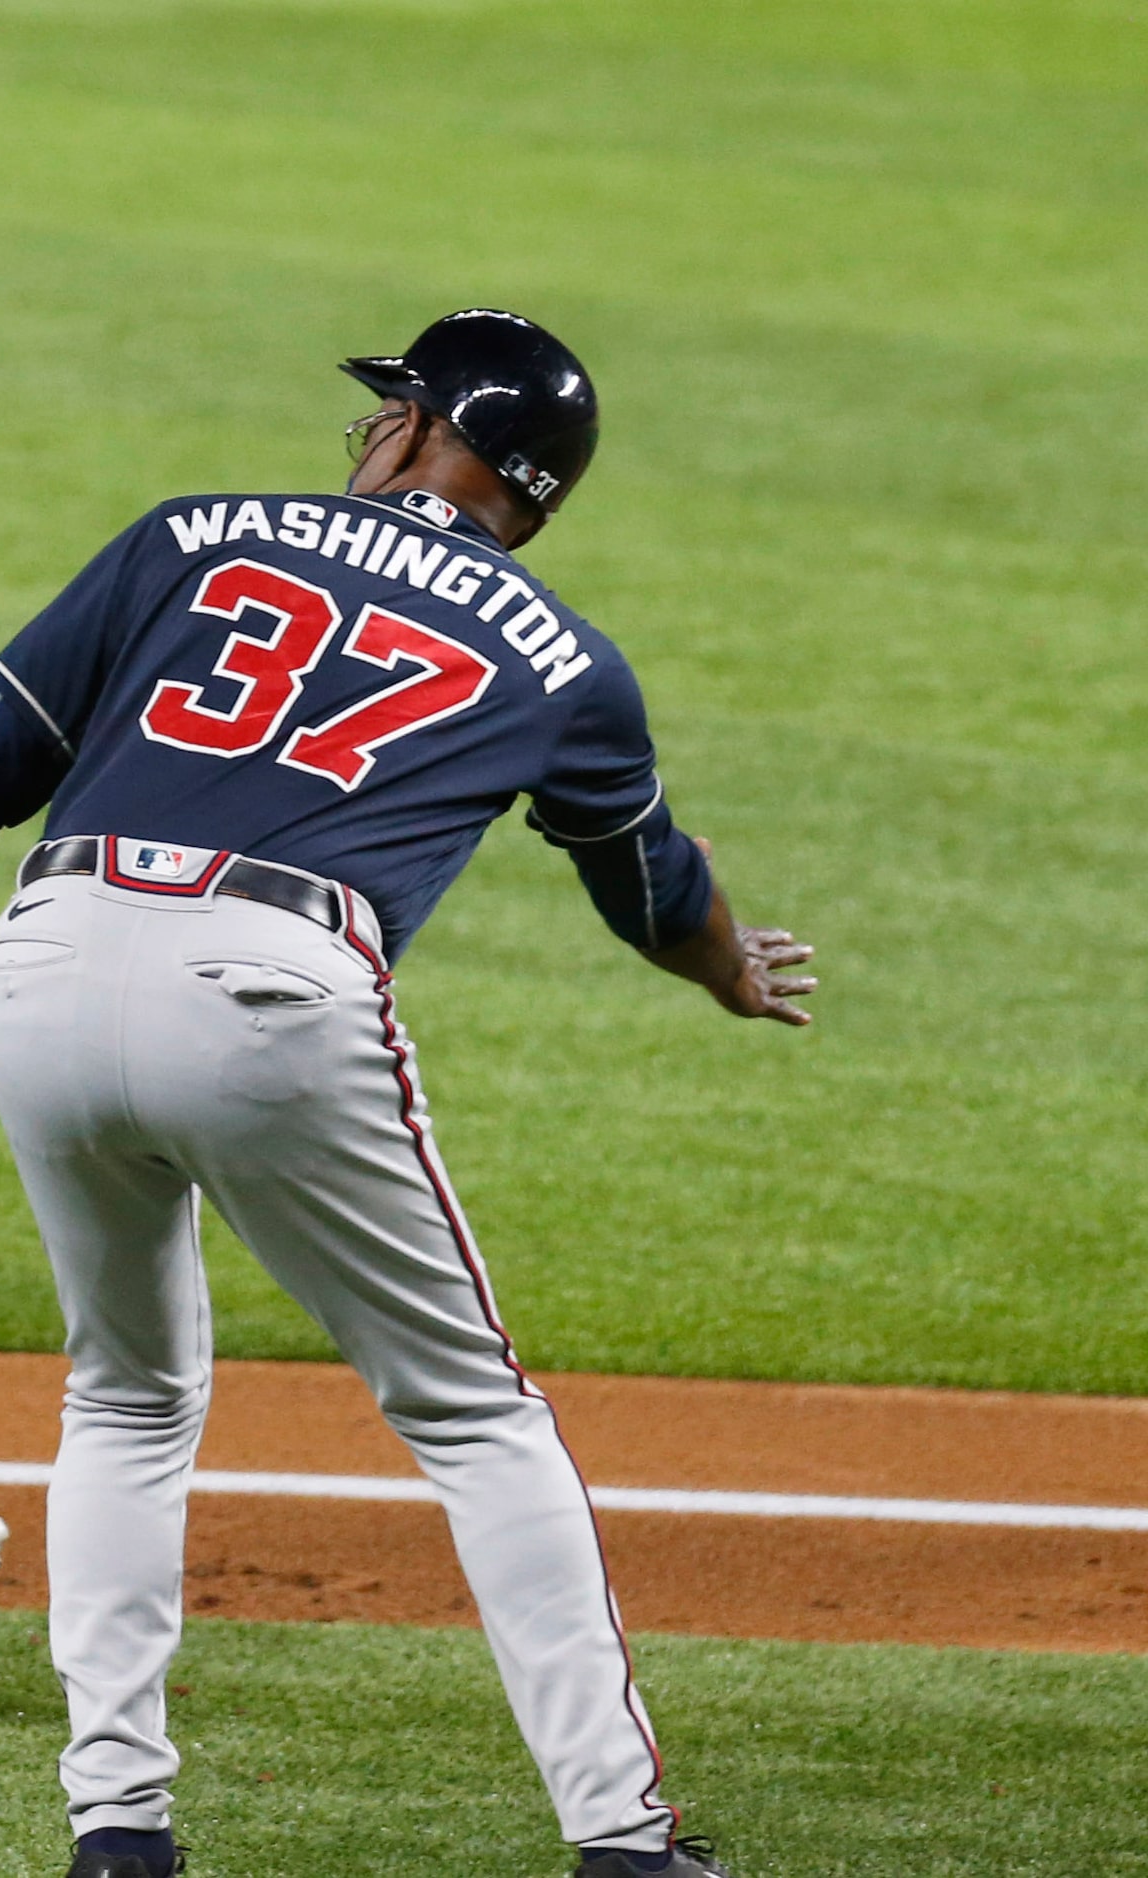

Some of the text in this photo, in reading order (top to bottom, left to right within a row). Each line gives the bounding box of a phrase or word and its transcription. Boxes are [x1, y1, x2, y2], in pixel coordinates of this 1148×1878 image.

[528, 470, 560, 501] 37
[138, 557, 499, 793] 37
[166, 500, 593, 695] WASHINGTON
